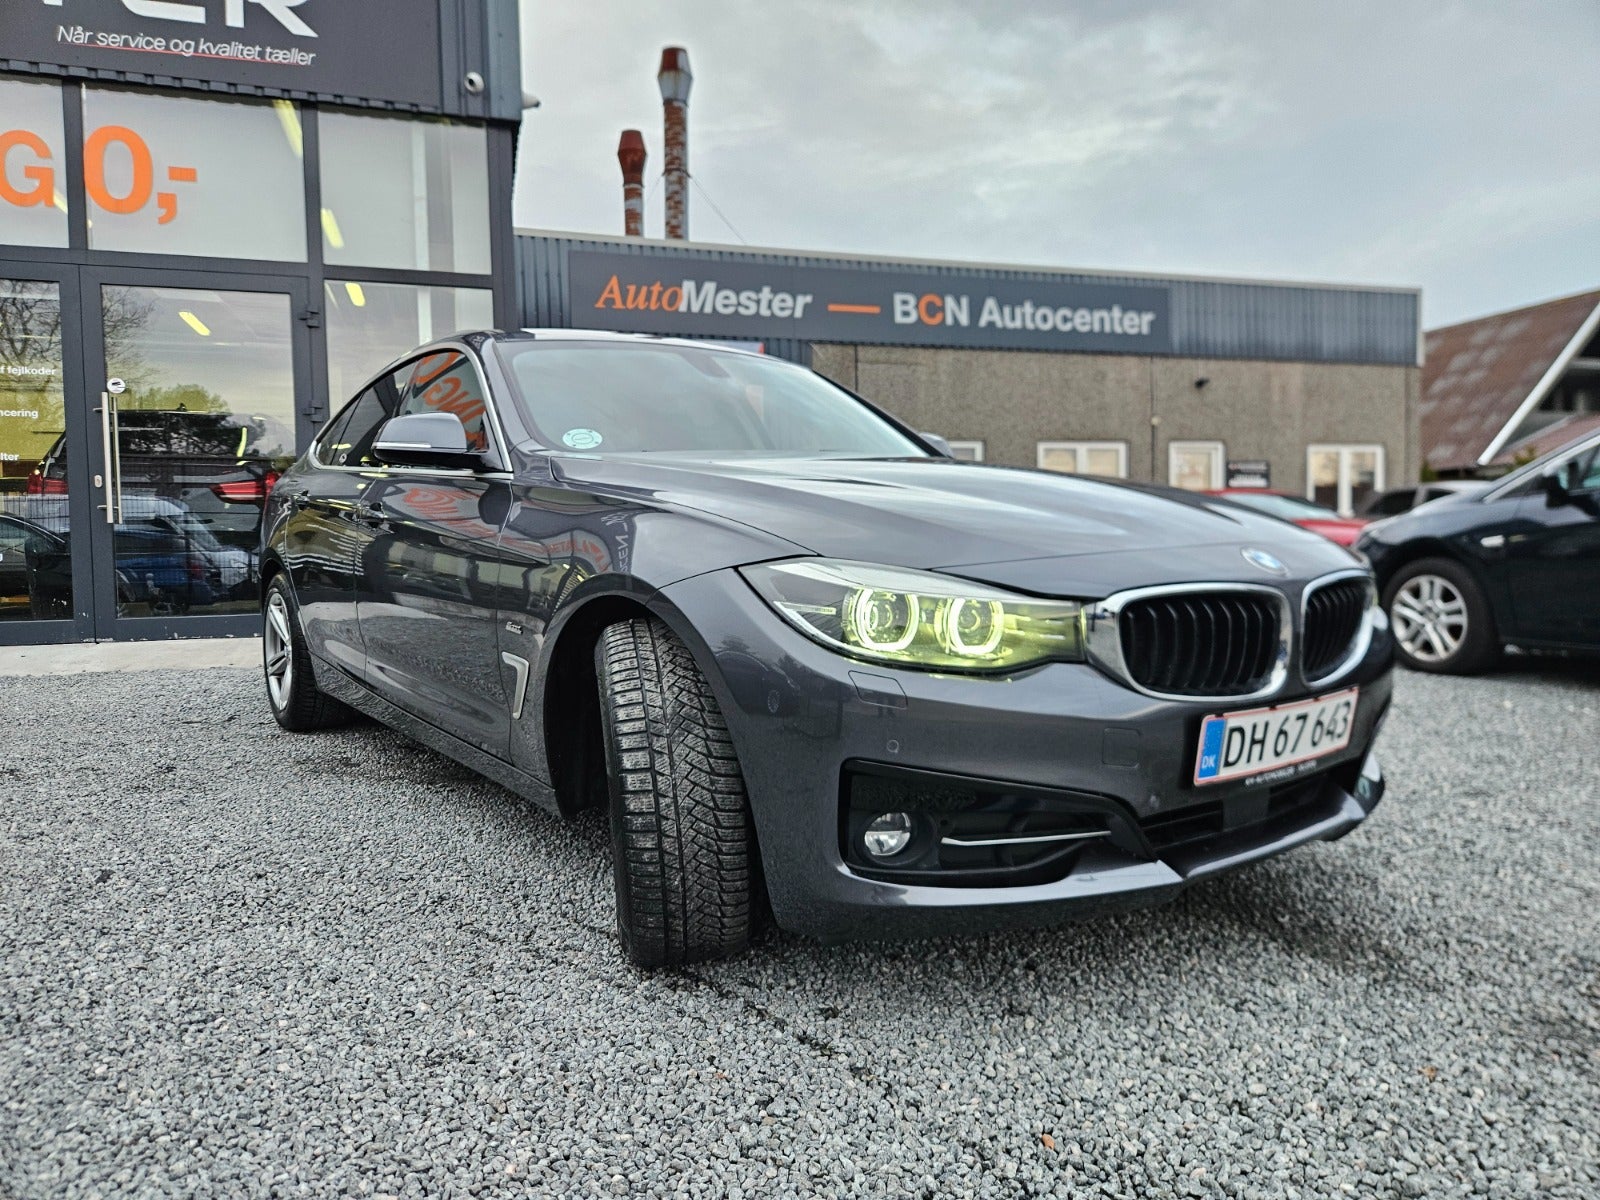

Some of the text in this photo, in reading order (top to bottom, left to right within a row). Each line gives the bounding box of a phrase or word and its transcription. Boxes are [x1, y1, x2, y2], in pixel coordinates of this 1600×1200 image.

[57, 25, 317, 66] Når service og kvalitet tæller
[595, 274, 1155, 335] AutoMester BCN Autocenter
[7, 365, 57, 376] fejlkoder
[1223, 720, 1269, 767] DH
[1274, 713, 1309, 757] 67
[1202, 754, 1216, 768] DK
